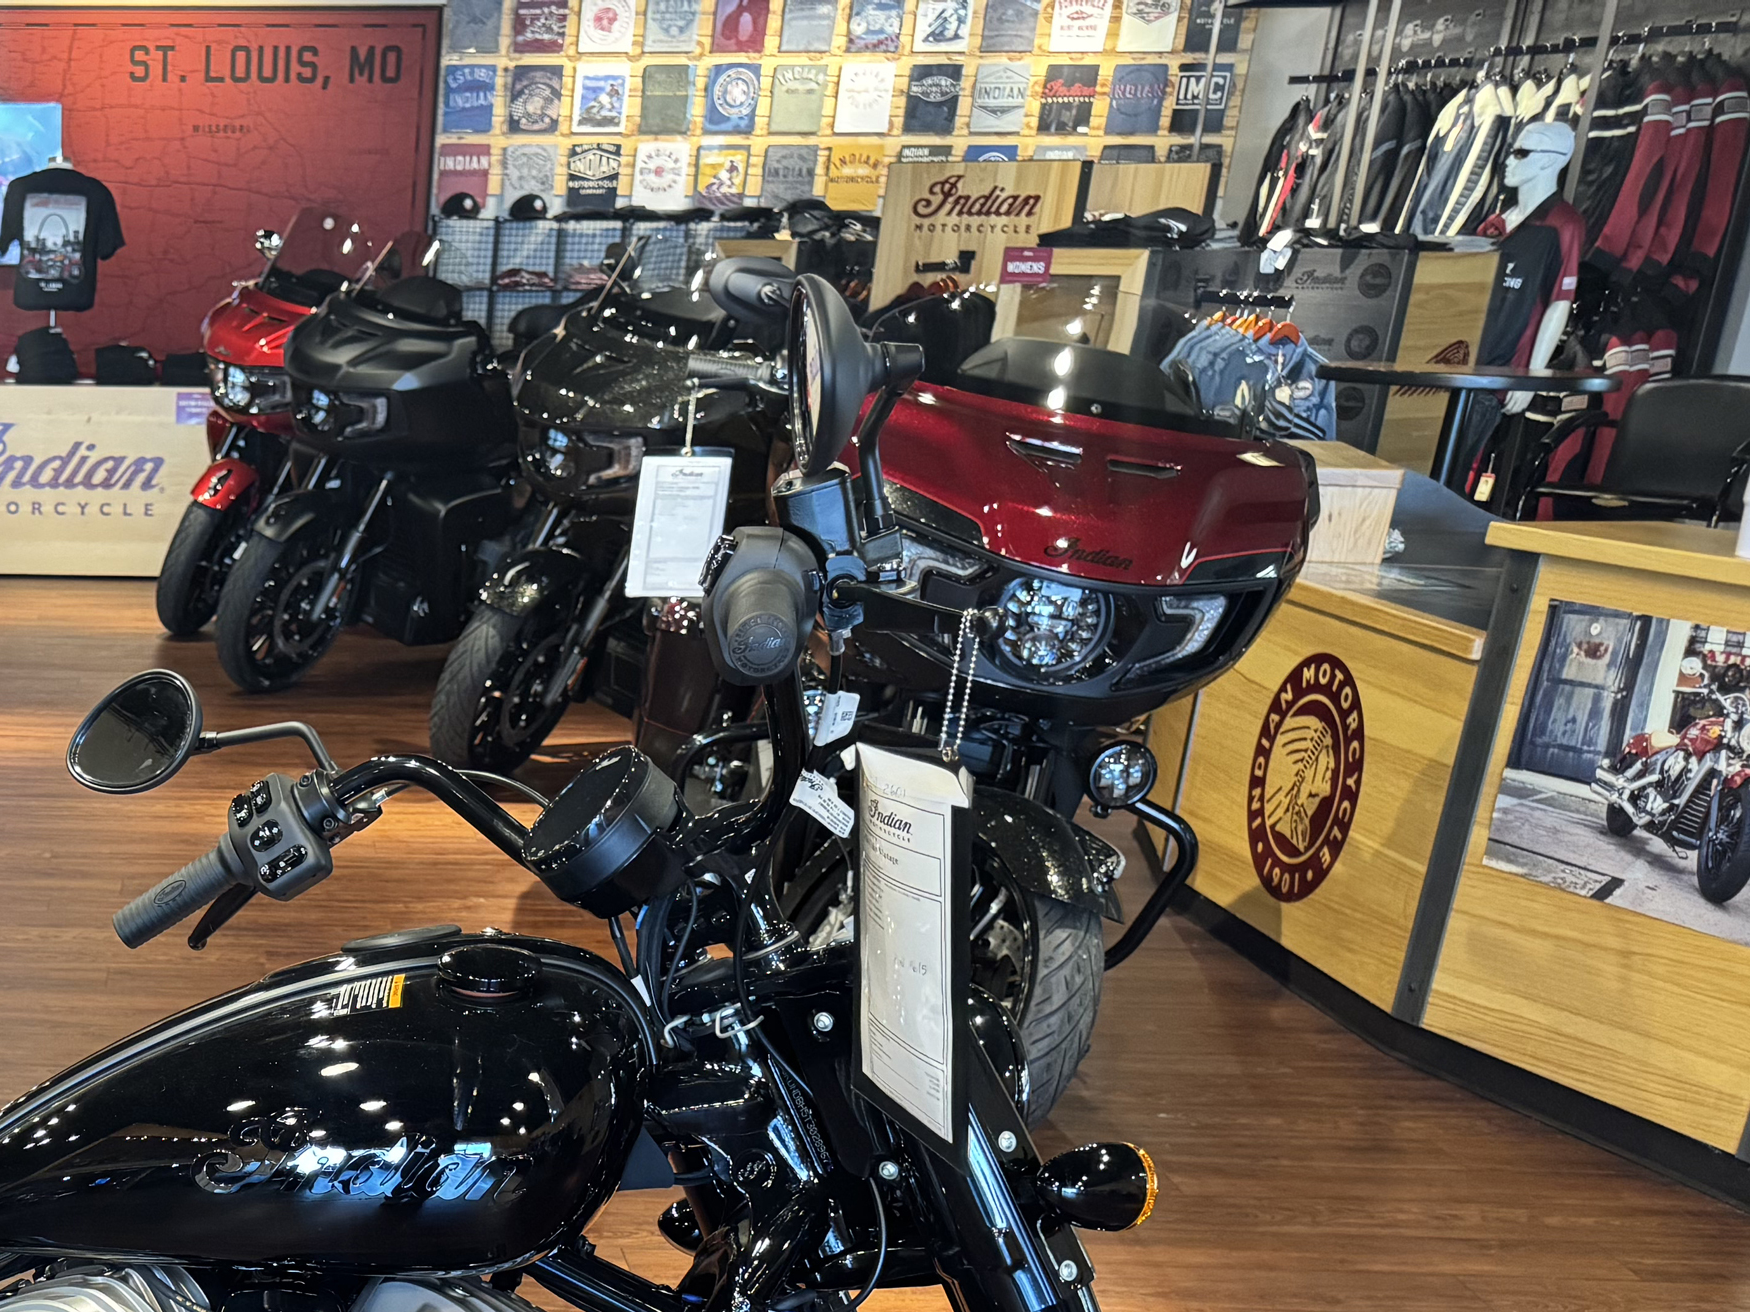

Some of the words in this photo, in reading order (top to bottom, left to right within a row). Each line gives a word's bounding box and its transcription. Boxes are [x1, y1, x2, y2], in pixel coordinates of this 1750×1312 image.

[129, 45, 187, 83] ST.
[204, 45, 332, 90] LOUIS,
[348, 45, 404, 84] MO
[977, 86, 1024, 100] INDIAN
[1179, 77, 1225, 99] IMC
[440, 155, 490, 171] INDIAN
[569, 153, 620, 179] INDIAN
[913, 174, 1042, 219] Indian
[914, 223, 1033, 235] MOTORCYCLE
[1006, 261, 1046, 274] WOMENS
[1043, 536, 1133, 571] Indian
[1251, 682, 1293, 830] INDIAN
[1302, 662, 1360, 869] MOTORCYCLE
[868, 798, 913, 834] Indian
[1263, 857, 1300, 894] 1901
[189, 1107, 535, 1200] Indian
